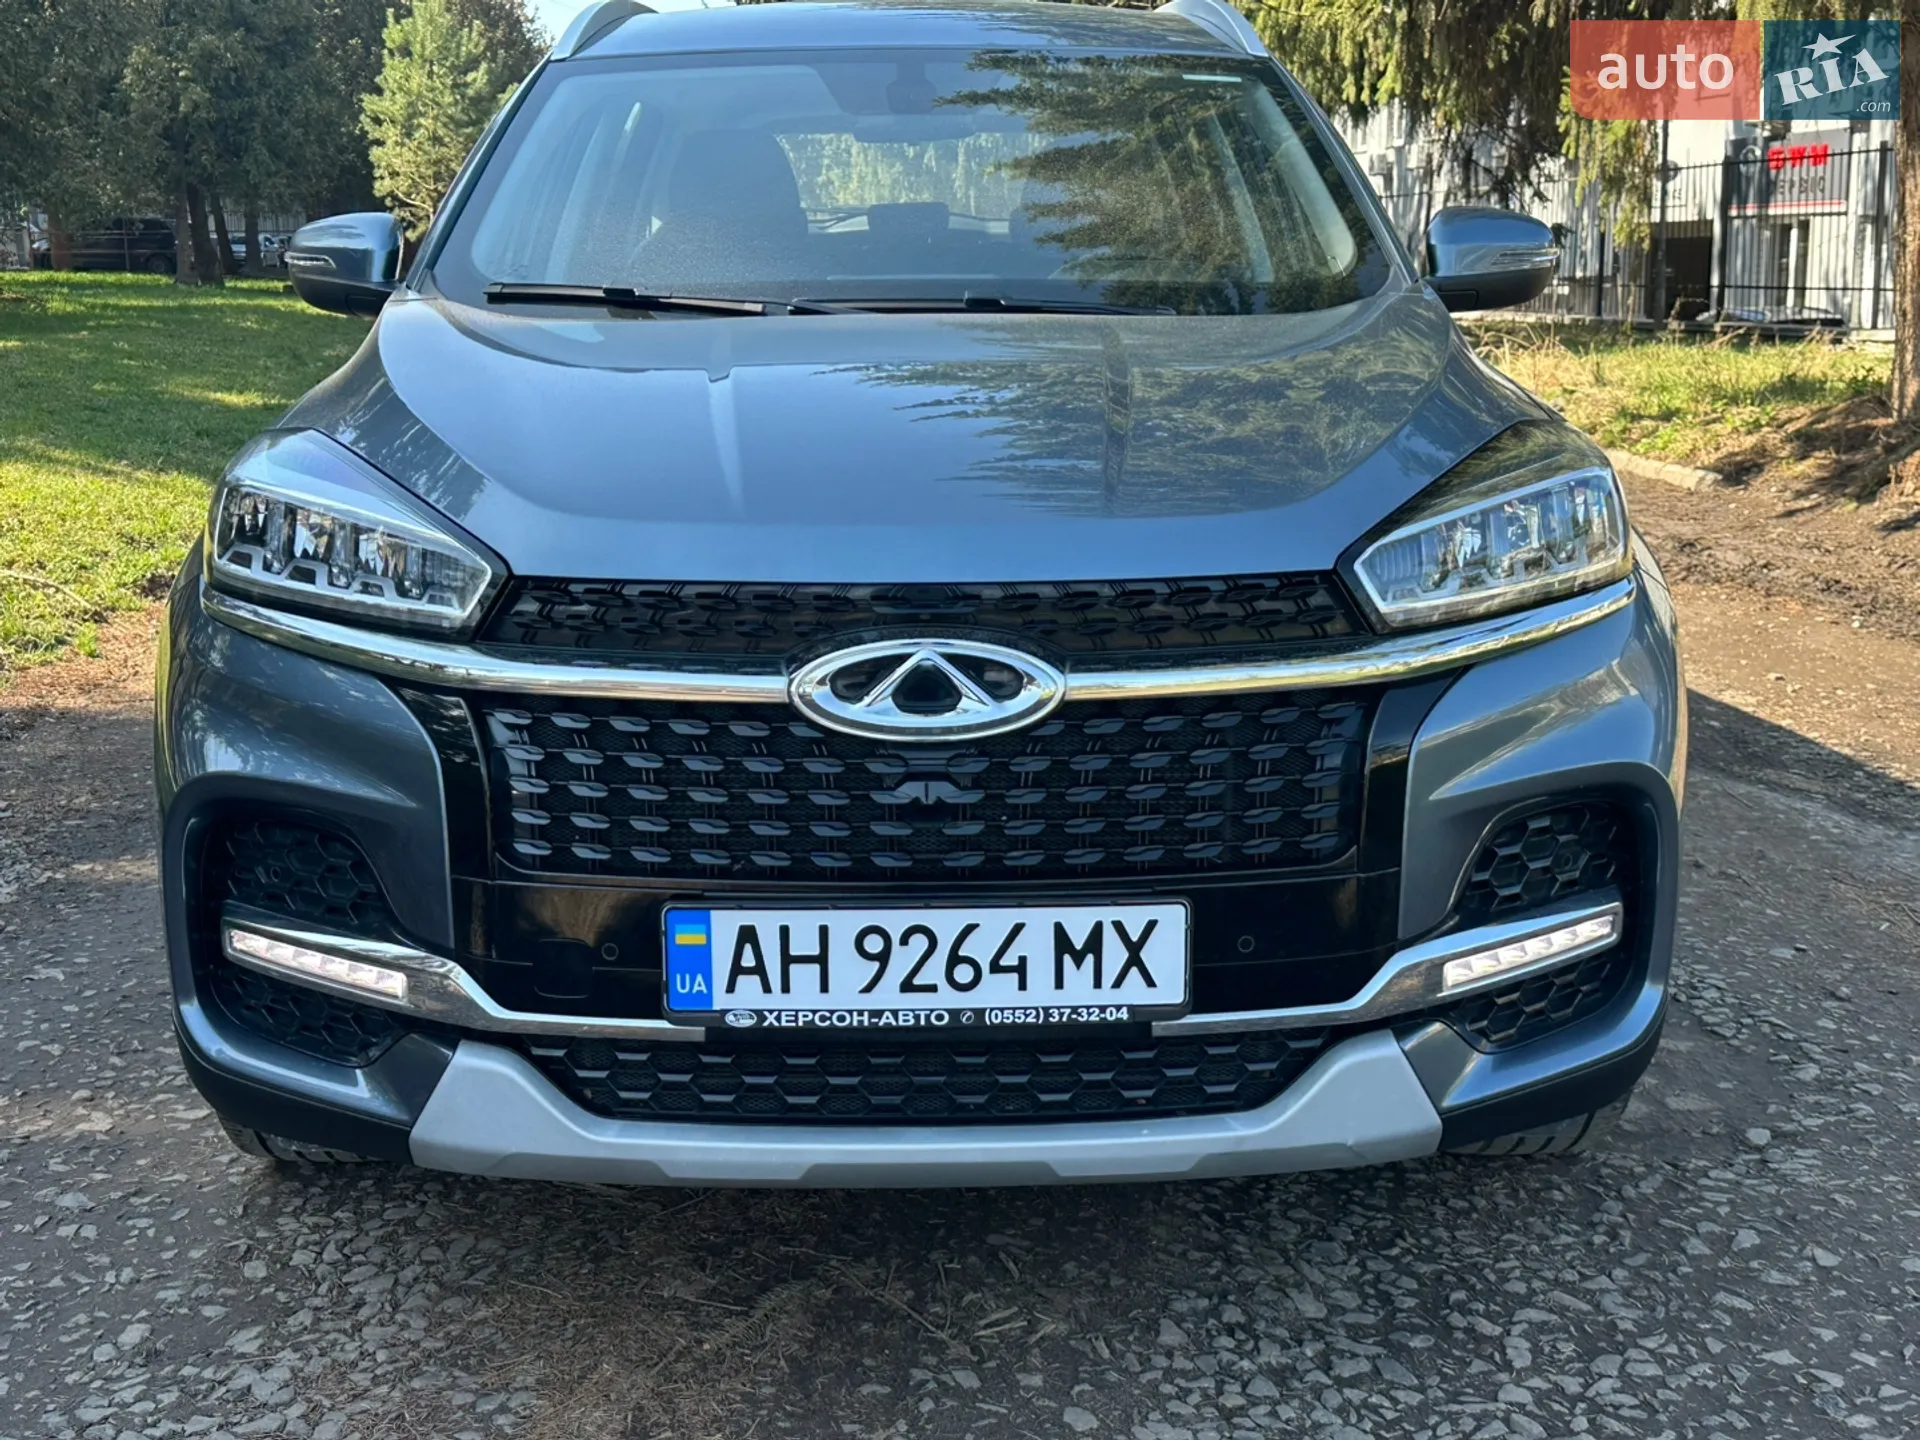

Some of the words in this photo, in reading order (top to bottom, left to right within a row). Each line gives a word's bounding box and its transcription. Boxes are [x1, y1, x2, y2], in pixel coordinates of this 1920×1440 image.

[725, 924, 830, 994] AH
[854, 922, 1028, 994] 9264
[1053, 918, 1159, 991] MX
[676, 973, 708, 994] UA
[762, 1010, 950, 1027] ХЕРСОН-АВТО
[985, 1007, 1044, 1026] (0552)
[1049, 1006, 1129, 1023] 37-32-04
